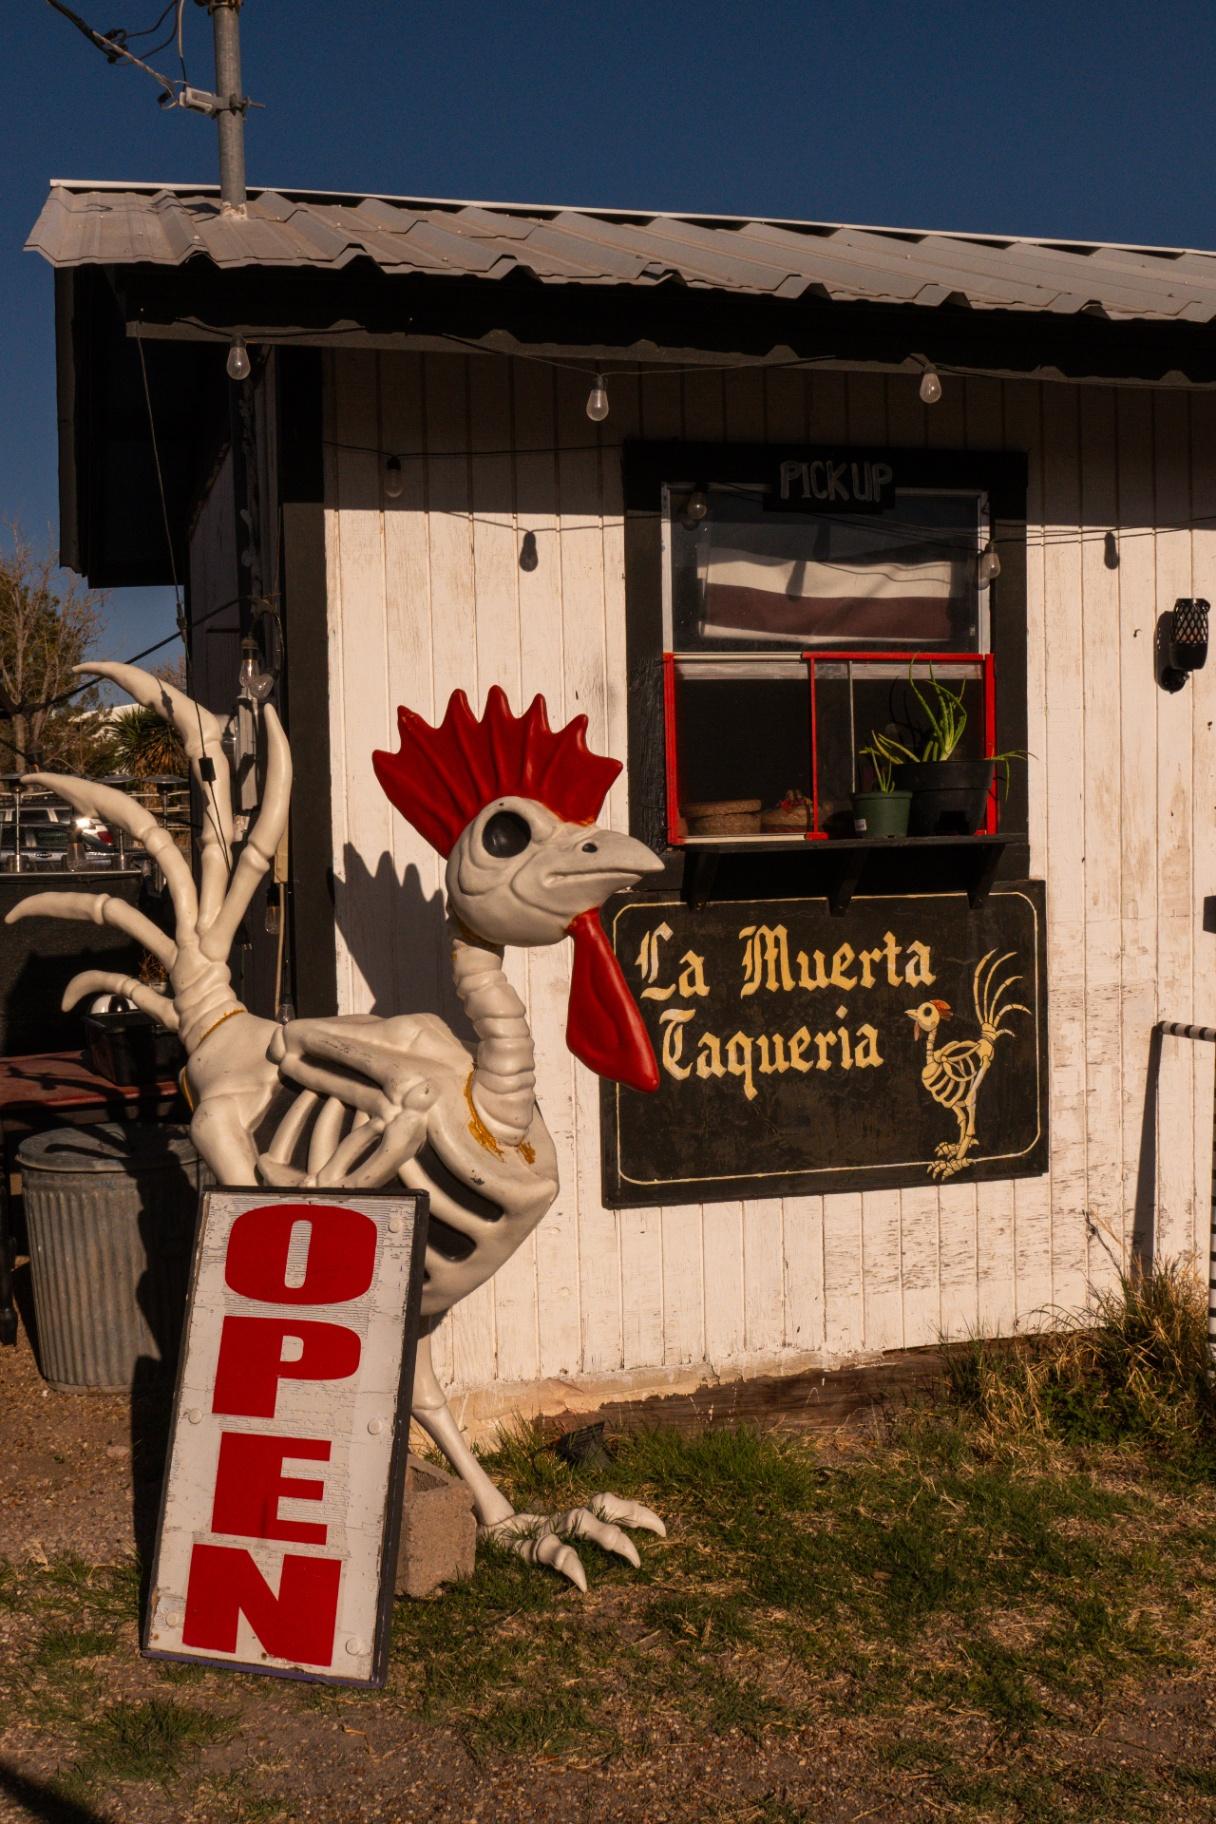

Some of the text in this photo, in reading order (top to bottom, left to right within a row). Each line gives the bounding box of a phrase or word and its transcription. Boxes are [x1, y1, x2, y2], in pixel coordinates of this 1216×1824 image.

[634, 921, 937, 1001] La Muerta
[658, 1004, 884, 1100] Taqueria
[182, 1203, 378, 1668] OPEN
